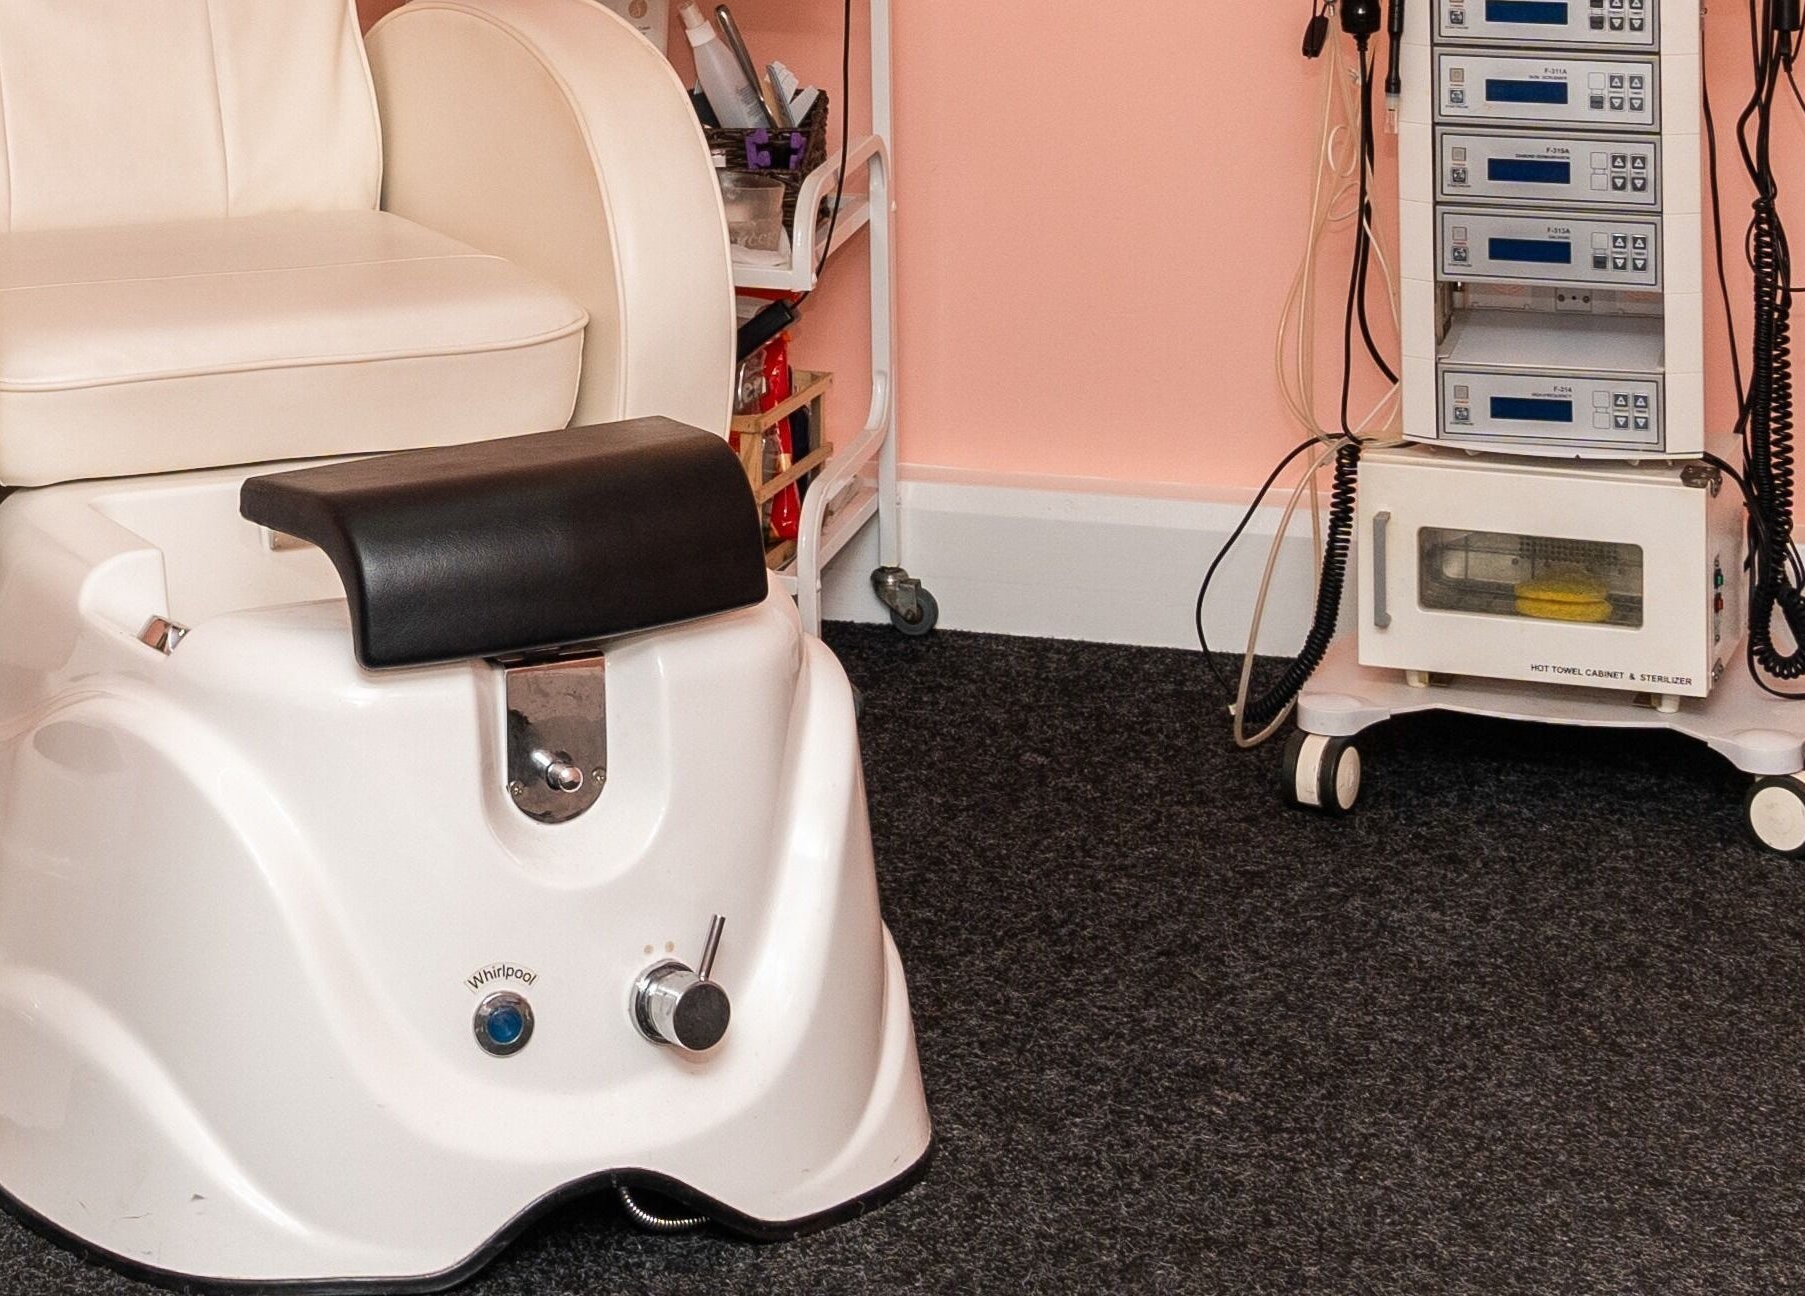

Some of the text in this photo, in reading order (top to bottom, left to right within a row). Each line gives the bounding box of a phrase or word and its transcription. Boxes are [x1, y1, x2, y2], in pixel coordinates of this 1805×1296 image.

[1530, 663, 1692, 686] HOT TOWEL CABINET & STERILIZER
[467, 963, 538, 989] Whirlpool
